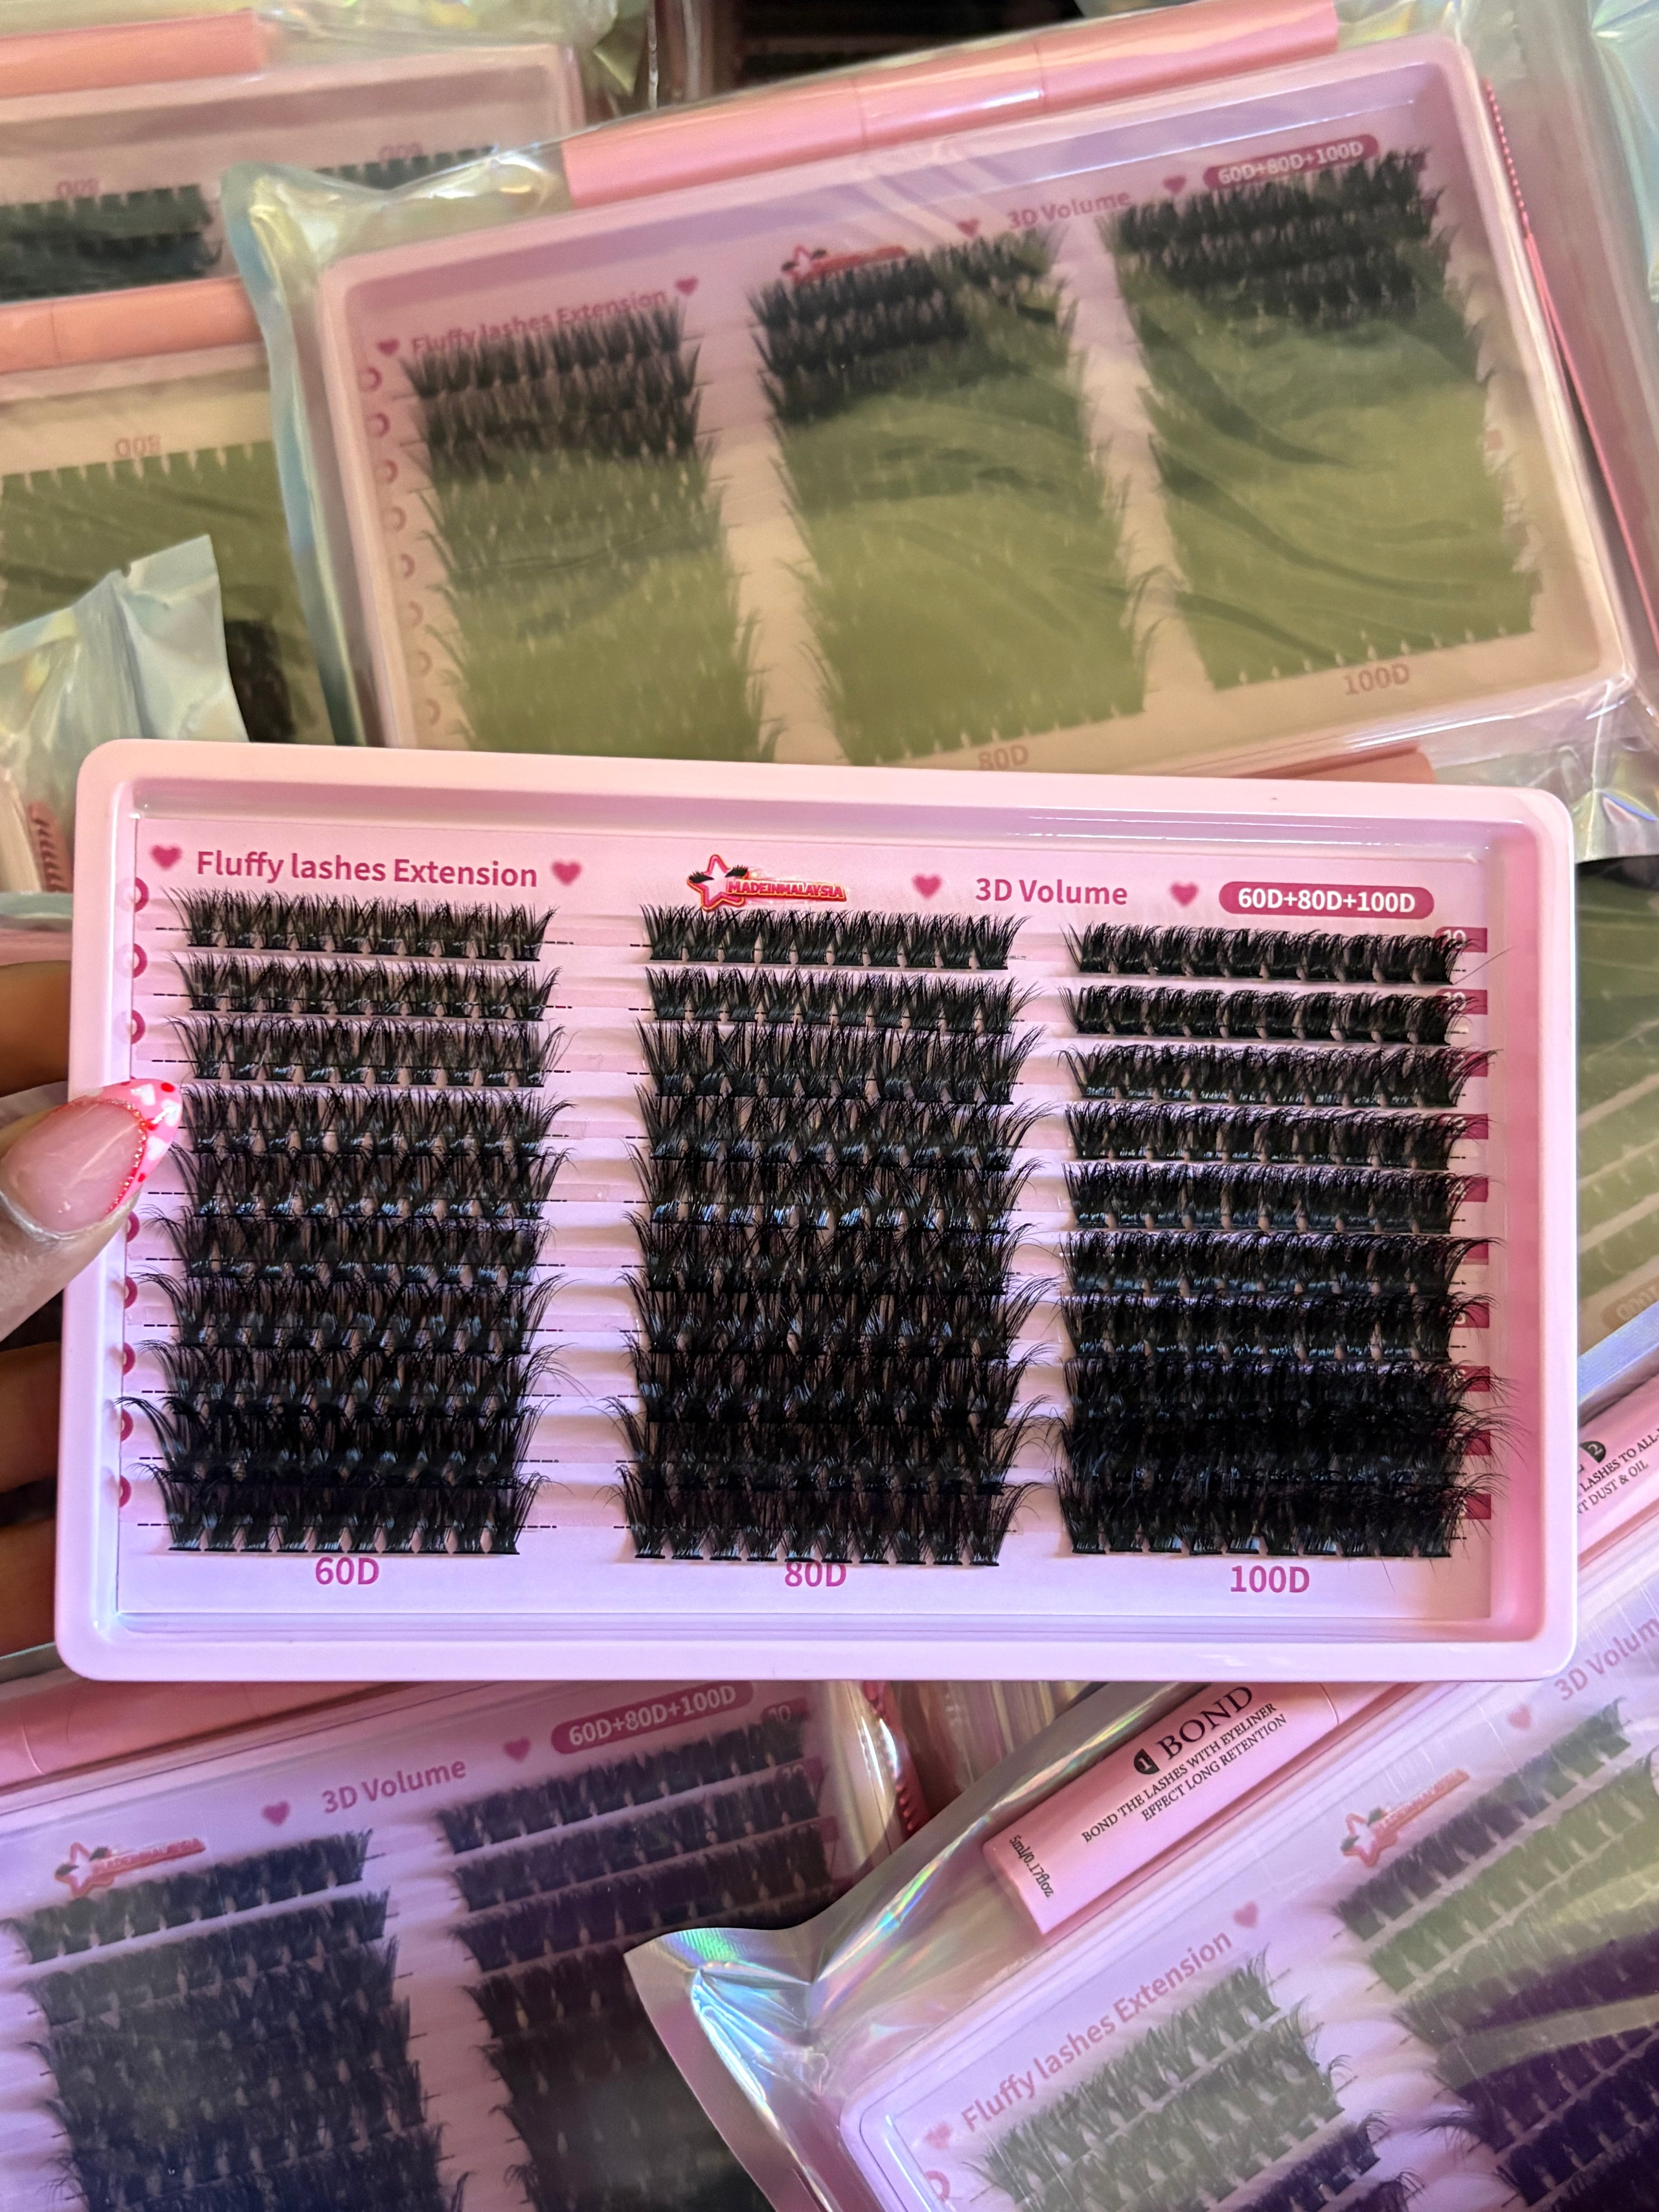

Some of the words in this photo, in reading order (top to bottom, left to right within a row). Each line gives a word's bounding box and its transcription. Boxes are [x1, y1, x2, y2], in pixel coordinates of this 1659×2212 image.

[1218, 141, 1363, 184] 60D+80D+100D
[1008, 209, 1037, 229] 3D
[1040, 193, 1131, 221] Volume
[1344, 662, 1411, 696] 100D
[978, 744, 1029, 770] 80D
[197, 851, 283, 883] Fluffy
[292, 854, 386, 881] lashes
[394, 859, 537, 887] Extension
[728, 880, 845, 898] MADEINMALAYSIA
[976, 877, 1011, 902] 3D
[1020, 879, 1128, 905] Volume
[1239, 888, 1415, 913] 60D+80D+100D
[1588, 1444, 1602, 1455] 2
[1580, 1459, 1620, 1492] LASHES
[1618, 1448, 1637, 1462] TO
[1588, 1479, 1618, 1505] DUST
[1618, 1475, 1629, 1485] &
[1628, 1460, 1649, 1477] OIL
[315, 1557, 379, 1585] 60D
[785, 1560, 846, 1588] 80D
[1230, 1565, 1309, 1593] 100D
[1555, 1668, 1587, 1700] 3D
[1585, 1618, 1659, 1675] Volum
[569, 1685, 736, 1745] 60D+80D+100D
[1138, 1757, 1152, 1770] 1
[1156, 1687, 1252, 1760] BOND
[1081, 1813, 1118, 1842] BOND
[1117, 1794, 1145, 1817] THE
[1143, 1764, 1188, 1800] LASHES
[1186, 1740, 1220, 1768] WITH
[1220, 1703, 1277, 1746] EYELINER
[1141, 1784, 1185, 1822] EFFECT
[1185, 1761, 1221, 1790] LONG
[1219, 1714, 1287, 1767] RETENTION
[322, 1786, 357, 1813] 3D
[362, 1761, 466, 1802] Volume
[961, 2068, 1035, 2133] Fluffy
[1032, 2014, 1117, 2079] lashes
[1112, 1931, 1233, 2024] Extension
